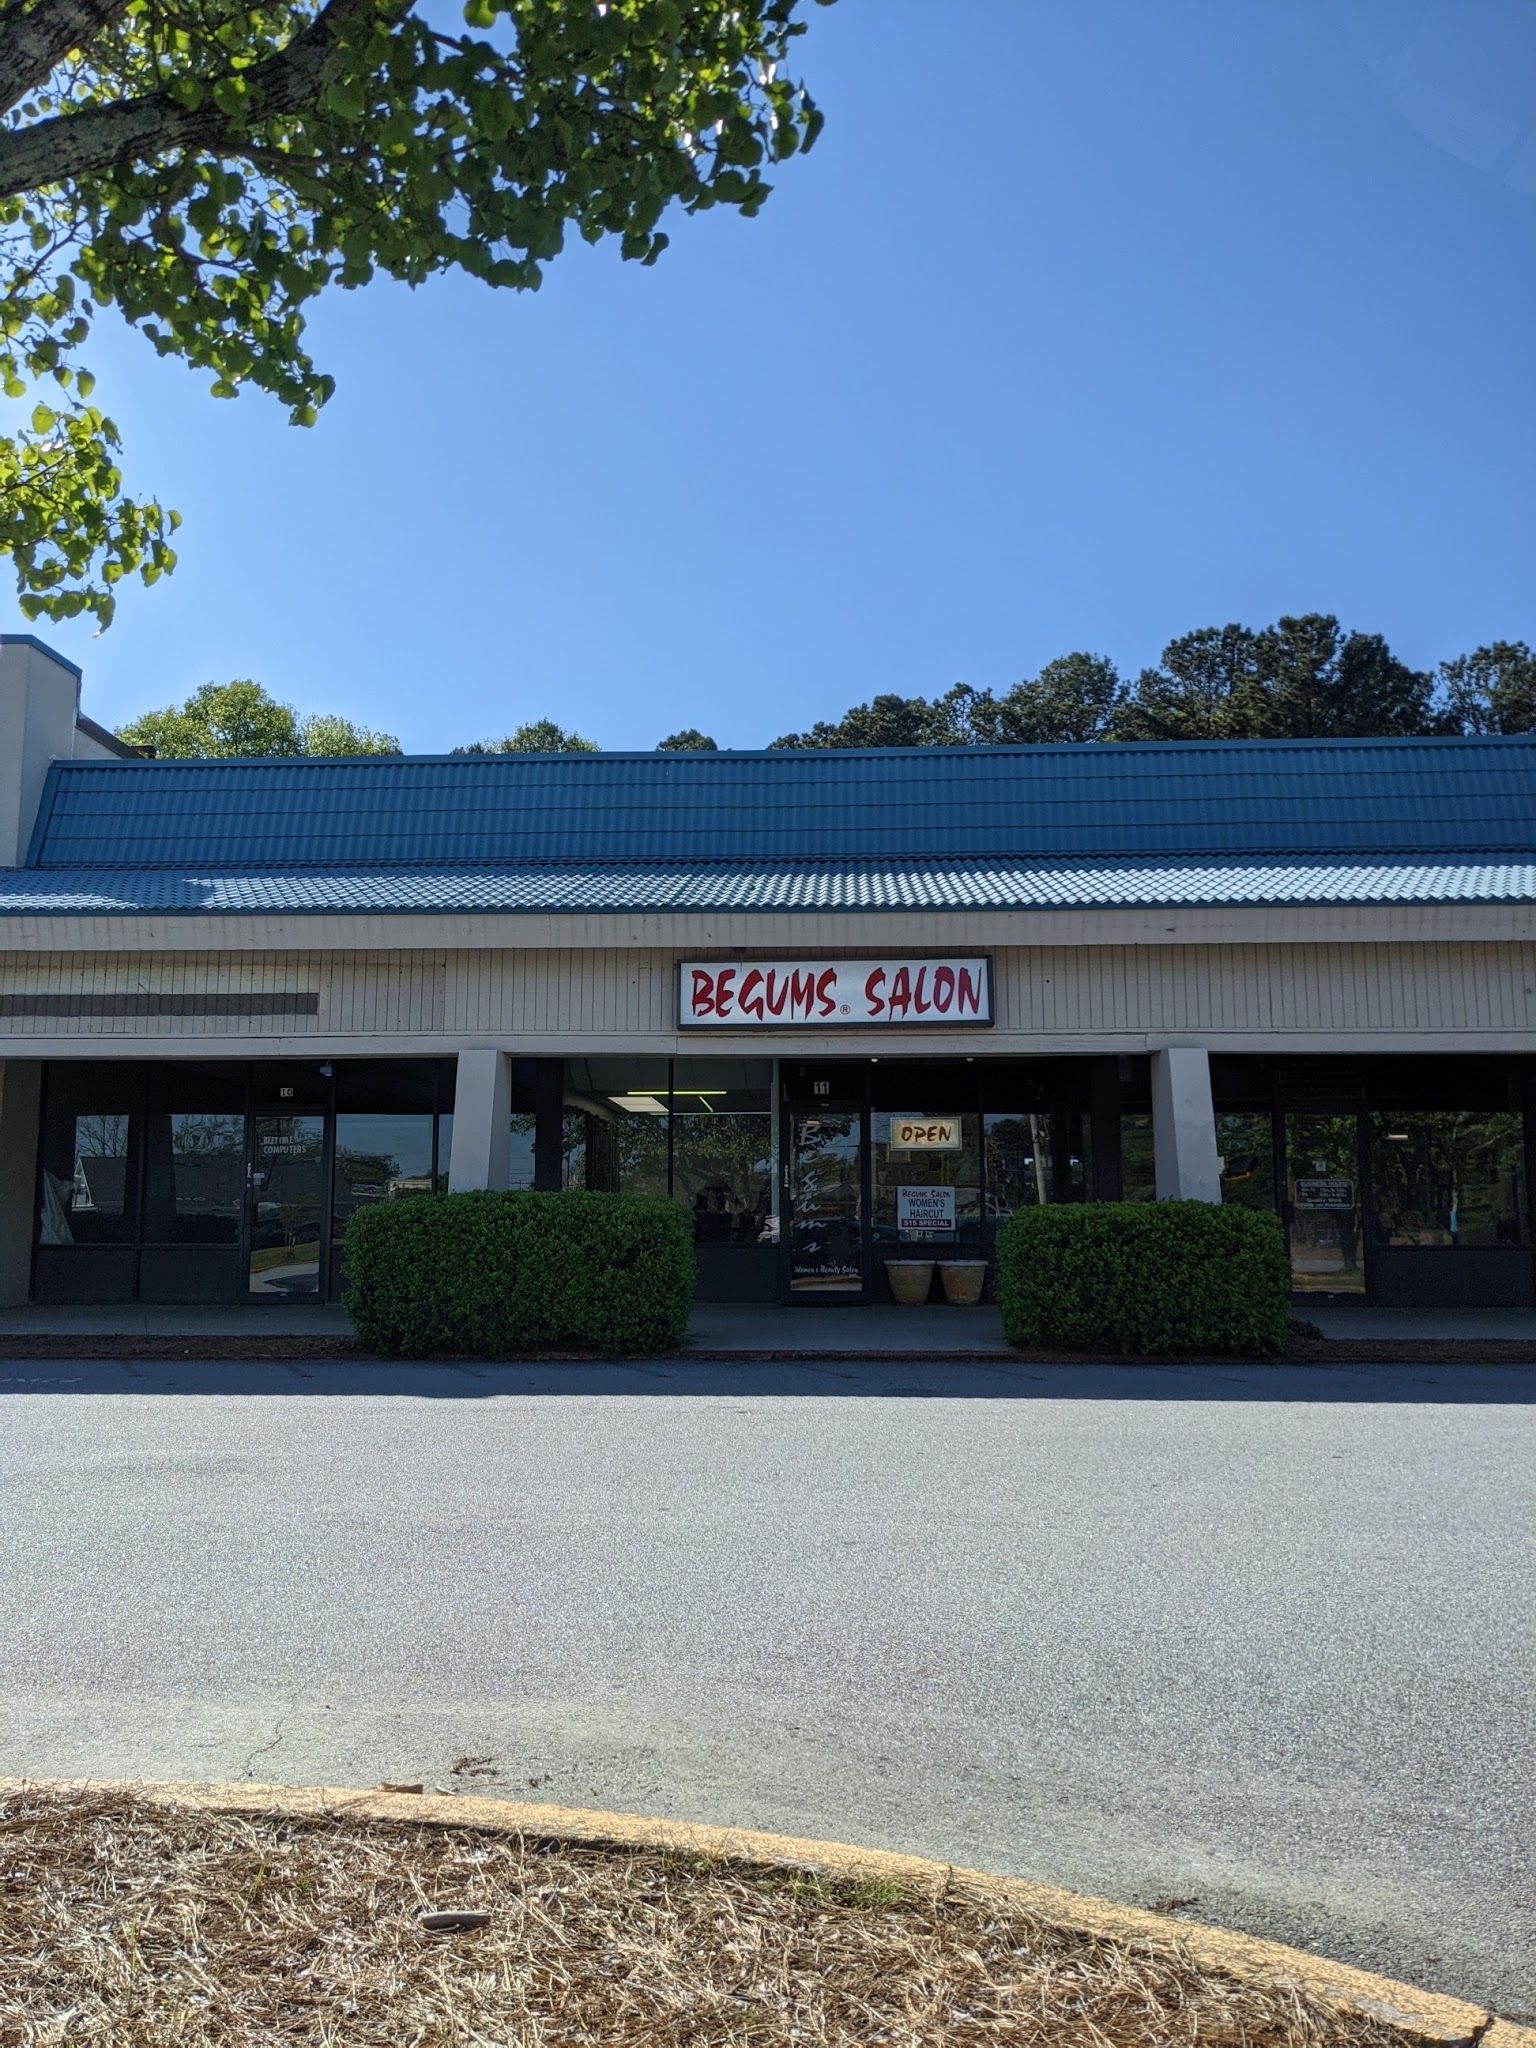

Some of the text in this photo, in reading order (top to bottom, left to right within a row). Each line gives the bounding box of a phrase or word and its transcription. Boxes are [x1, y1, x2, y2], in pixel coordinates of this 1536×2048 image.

[691, 967, 838, 1021] BEGUMS
[864, 966, 983, 1021] SALON
[815, 1081, 828, 1094] 11
[901, 1126, 952, 1142] OPEN
[263, 1145, 307, 1154] COMPUTERS
[908, 1198, 945, 1208] WOMEN'S
[910, 1209, 944, 1218] HAIRCUT
[918, 1219, 950, 1227] SPECIAL
